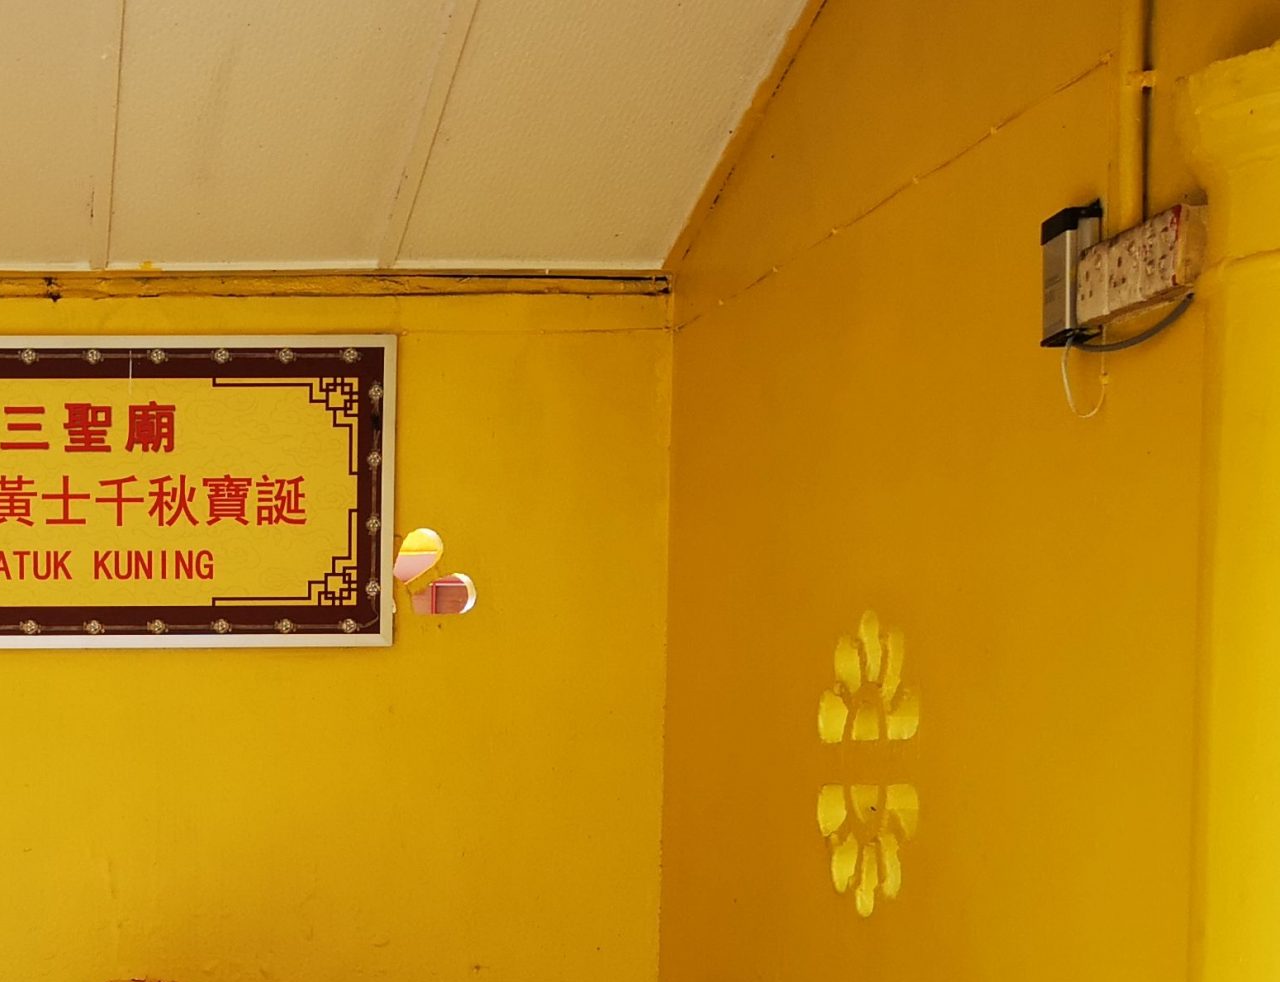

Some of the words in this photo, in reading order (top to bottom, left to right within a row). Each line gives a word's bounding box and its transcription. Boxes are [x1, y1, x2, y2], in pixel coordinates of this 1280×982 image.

[0, 400, 176, 453] 三聖廟
[93, 550, 215, 581] KUNING
